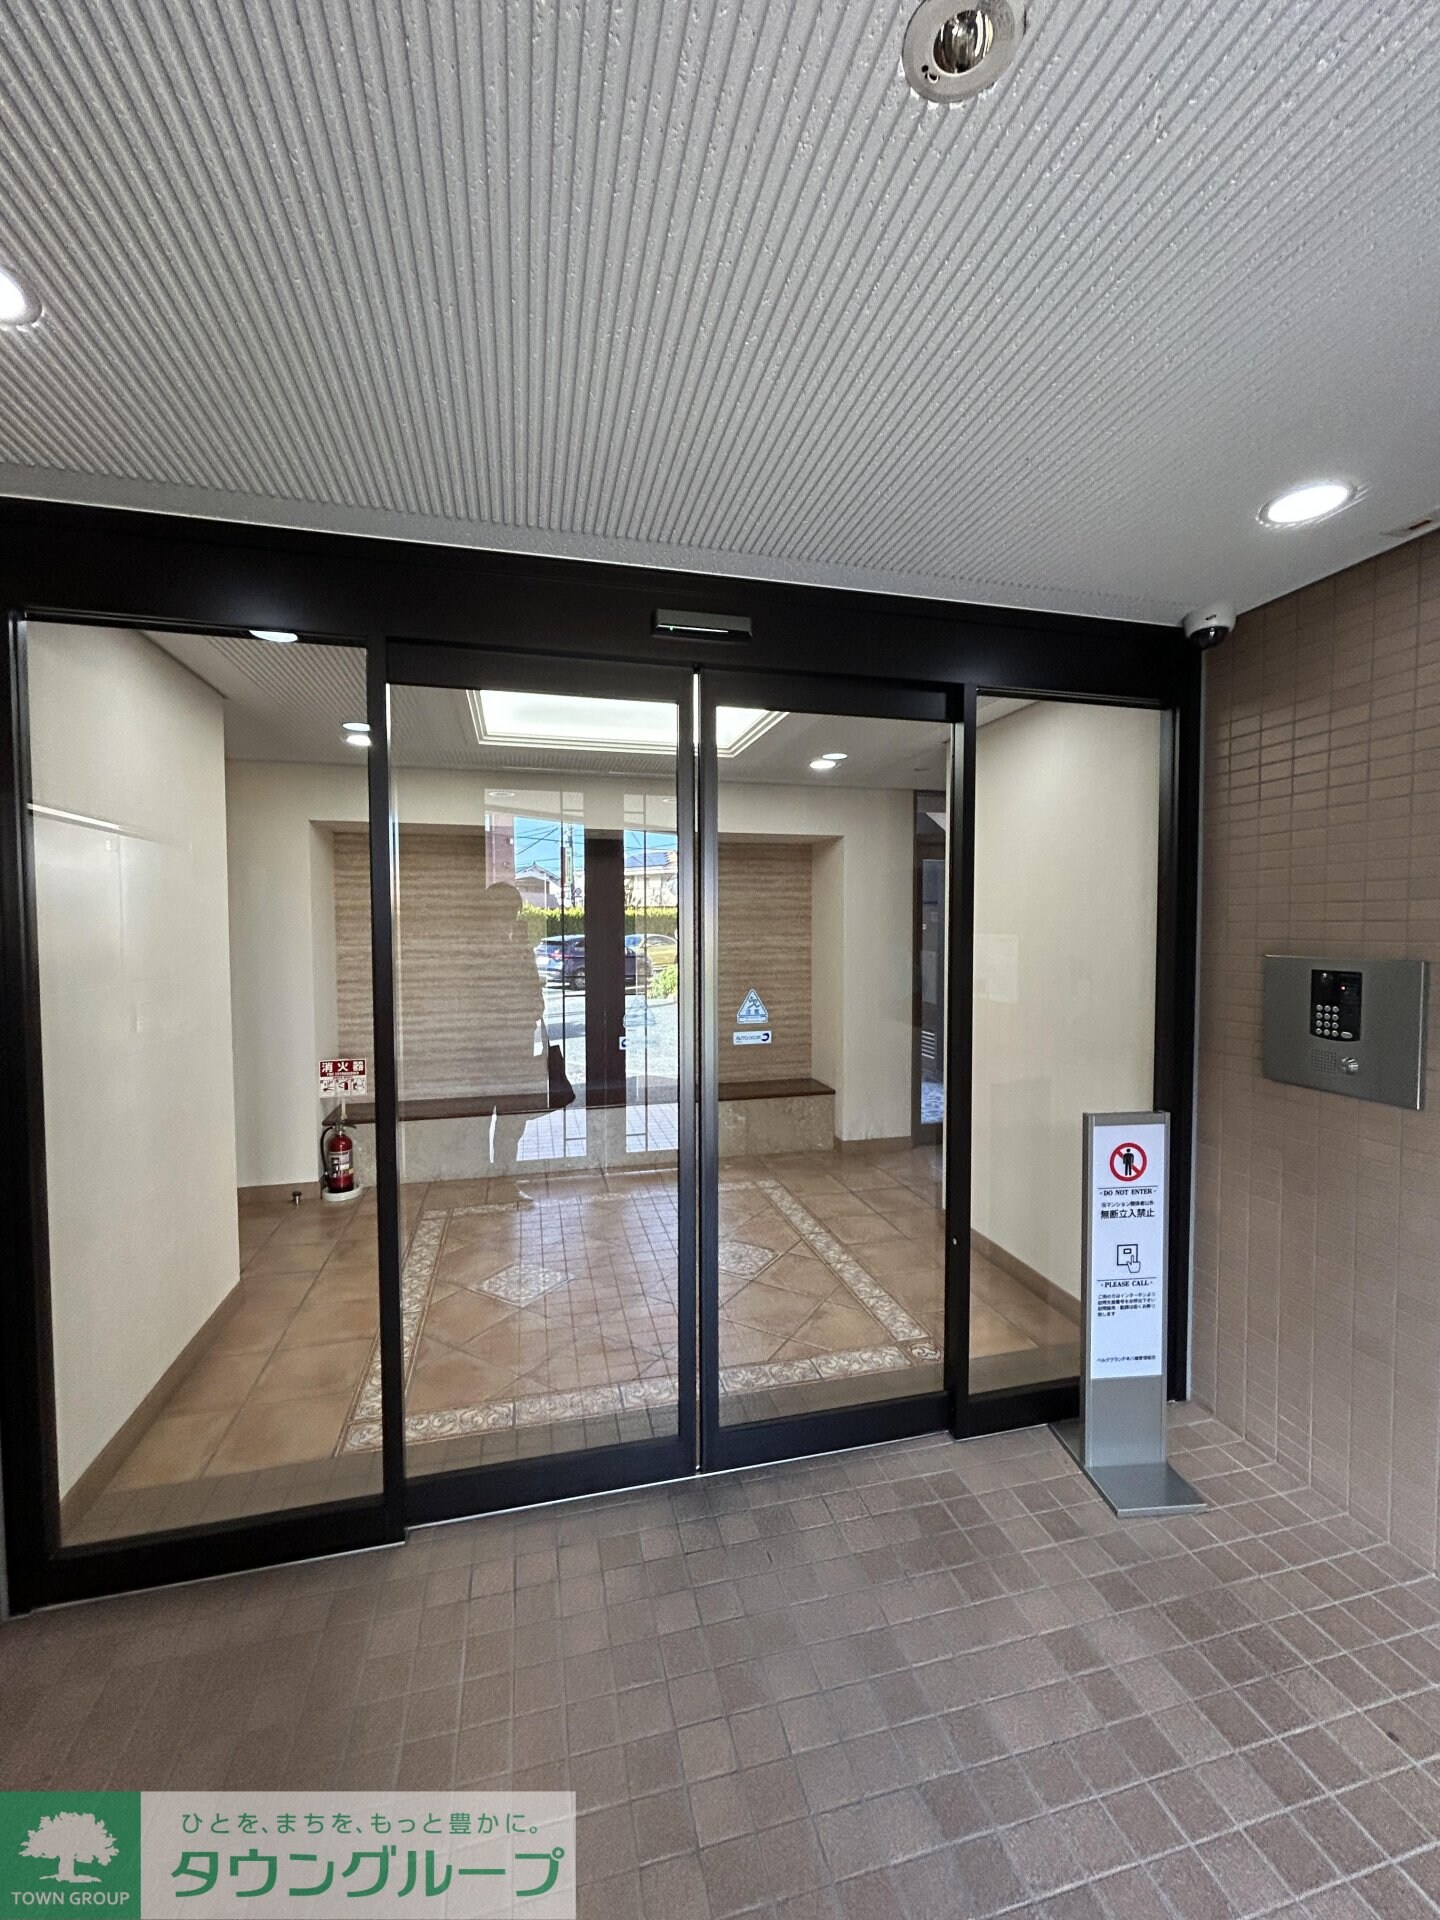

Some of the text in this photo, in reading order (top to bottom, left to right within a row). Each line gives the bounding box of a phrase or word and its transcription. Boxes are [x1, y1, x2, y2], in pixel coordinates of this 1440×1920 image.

[321, 1061, 364, 1072] 消火器
[1100, 1208, 1155, 1219] 無断立入禁止
